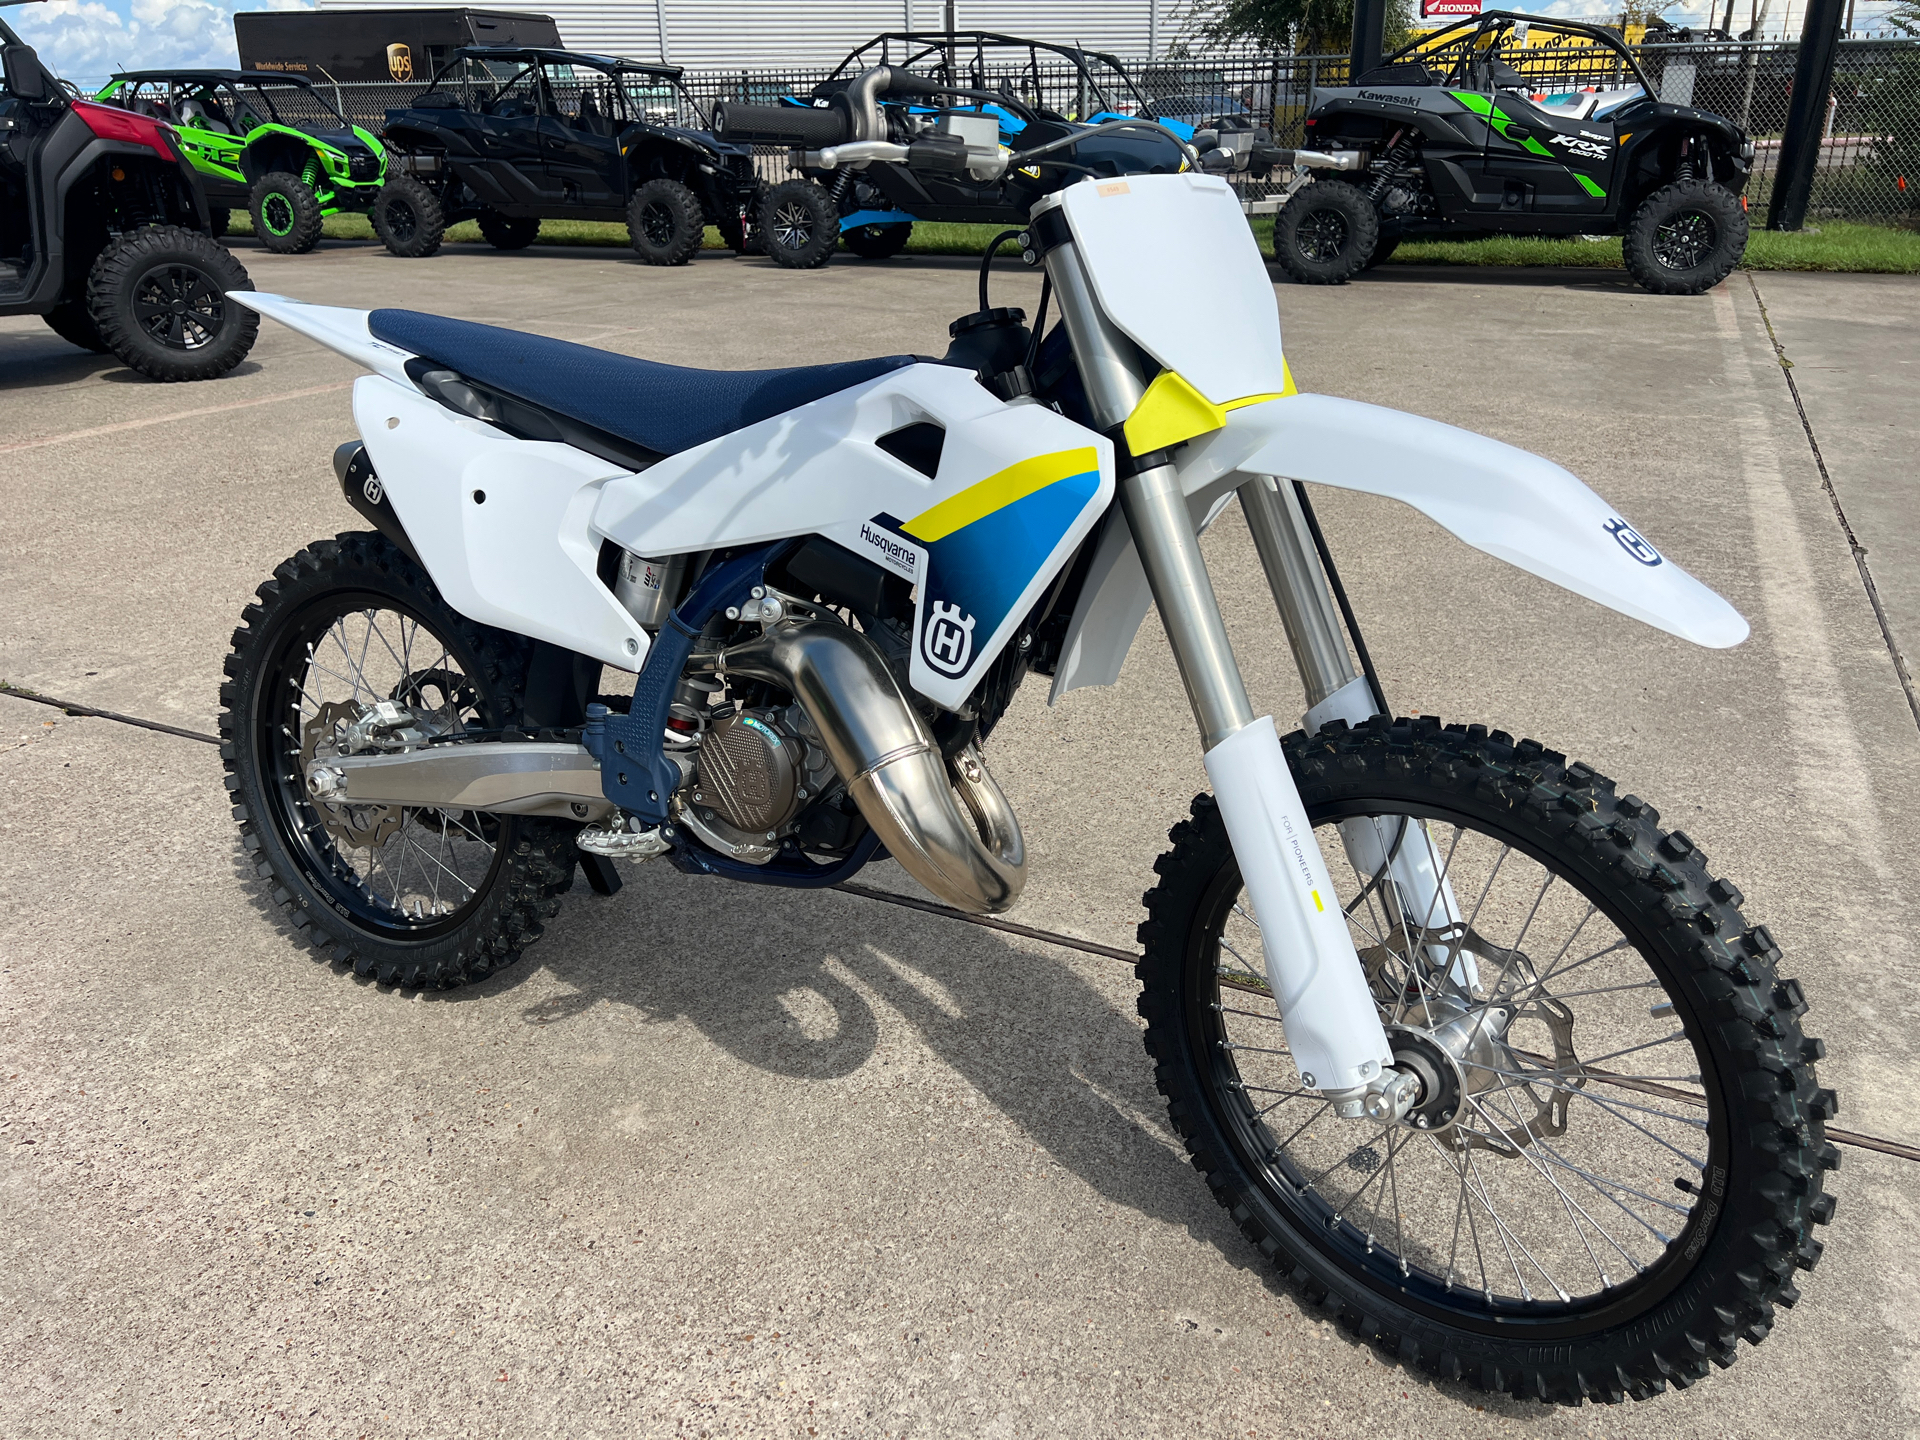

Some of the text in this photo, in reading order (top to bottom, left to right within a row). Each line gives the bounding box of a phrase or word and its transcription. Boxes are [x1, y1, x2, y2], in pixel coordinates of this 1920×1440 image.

[1439, 4, 1480, 12] HONDA
[255, 61, 308, 71] Worldwide Services
[390, 55, 411, 78] ups
[1357, 90, 1422, 107] Kawasaki
[1549, 133, 1612, 155] KRX
[860, 523, 916, 566] Husqvarna
[885, 555, 914, 575] MOTORCYCLES
[752, 720, 781, 746] MOTOREX
[1281, 815, 1314, 887] FOR PIONEERS
